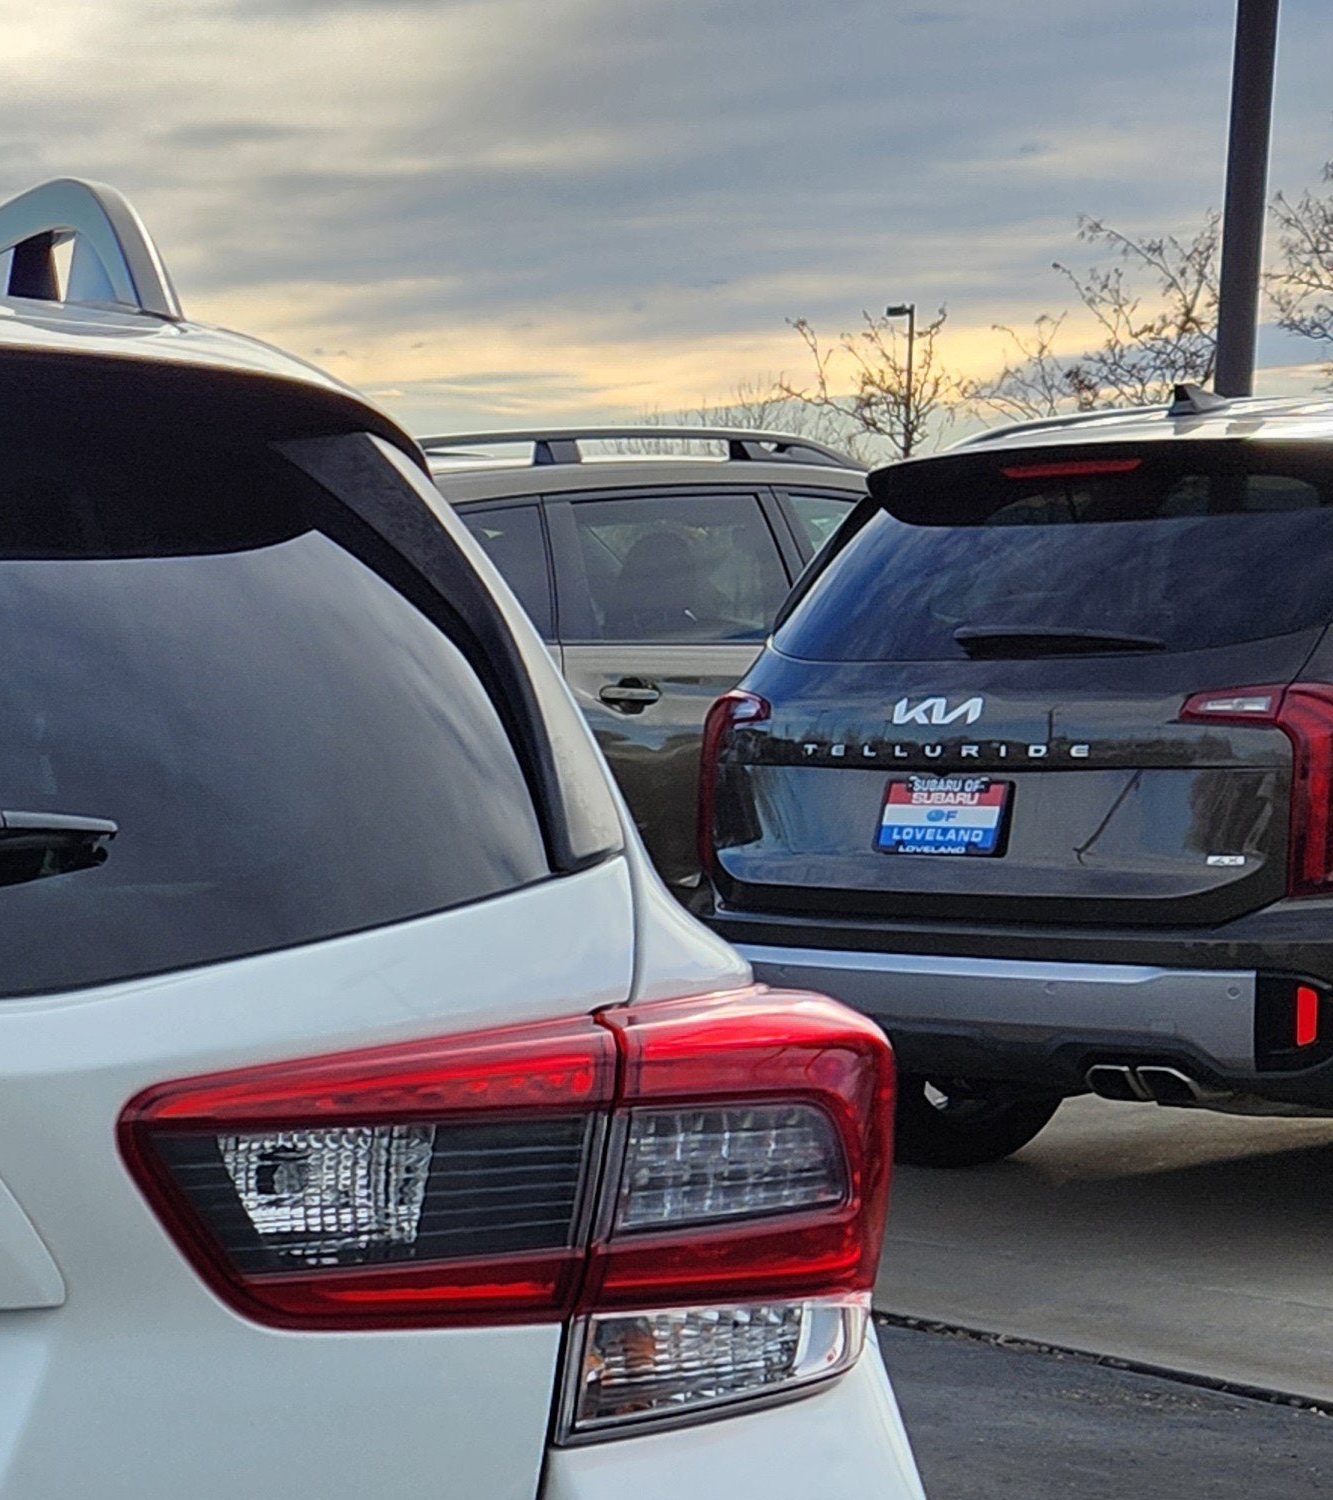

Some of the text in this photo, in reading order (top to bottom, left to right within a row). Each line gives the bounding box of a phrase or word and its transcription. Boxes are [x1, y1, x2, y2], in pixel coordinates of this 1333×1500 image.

[892, 697, 983, 724] KIA
[803, 744, 1090, 758] TELLURIDE
[913, 779, 962, 792] SUBARU
[911, 792, 979, 804] SUBARU
[892, 827, 983, 843] LOVELAND
[898, 844, 966, 854] LOVELAND
